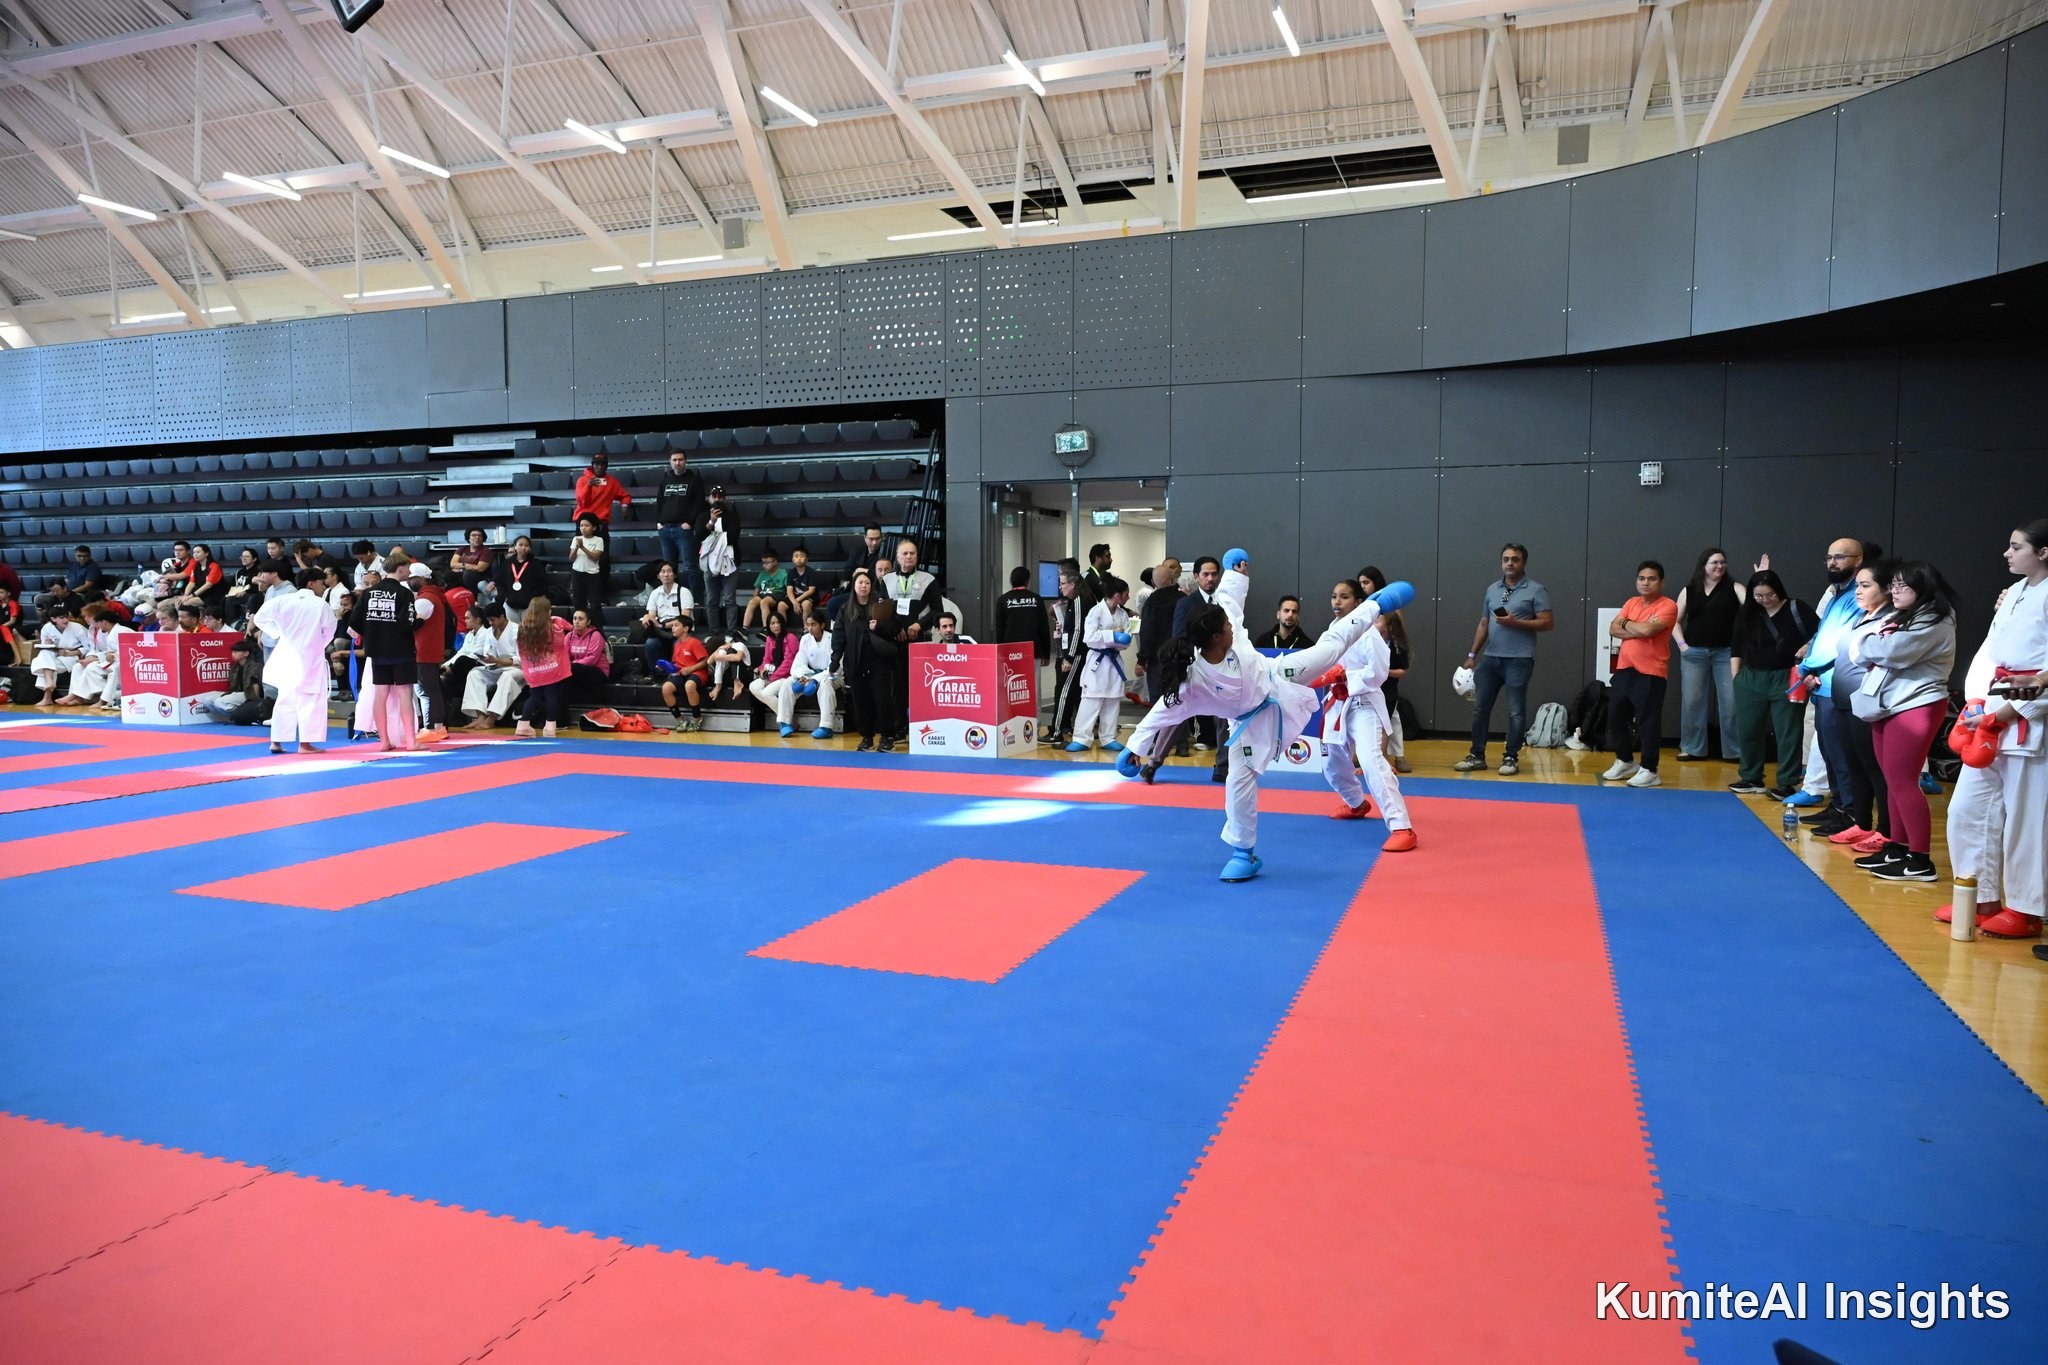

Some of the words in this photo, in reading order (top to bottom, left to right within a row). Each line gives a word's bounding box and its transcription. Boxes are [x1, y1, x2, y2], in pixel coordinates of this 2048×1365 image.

[369, 590, 396, 599] TEAM
[937, 654, 968, 662] COACH
[1008, 652, 1022, 660] COACH
[138, 664, 164, 672] KARATE
[202, 662, 230, 670] KARATE
[138, 672, 168, 681] ONTARIO
[202, 670, 230, 680] ONTARI
[938, 682, 976, 694] KARATE
[1010, 680, 1028, 690] KARATE
[938, 693, 981, 704] ONTARIO
[1010, 690, 1030, 702] ONTARIO
